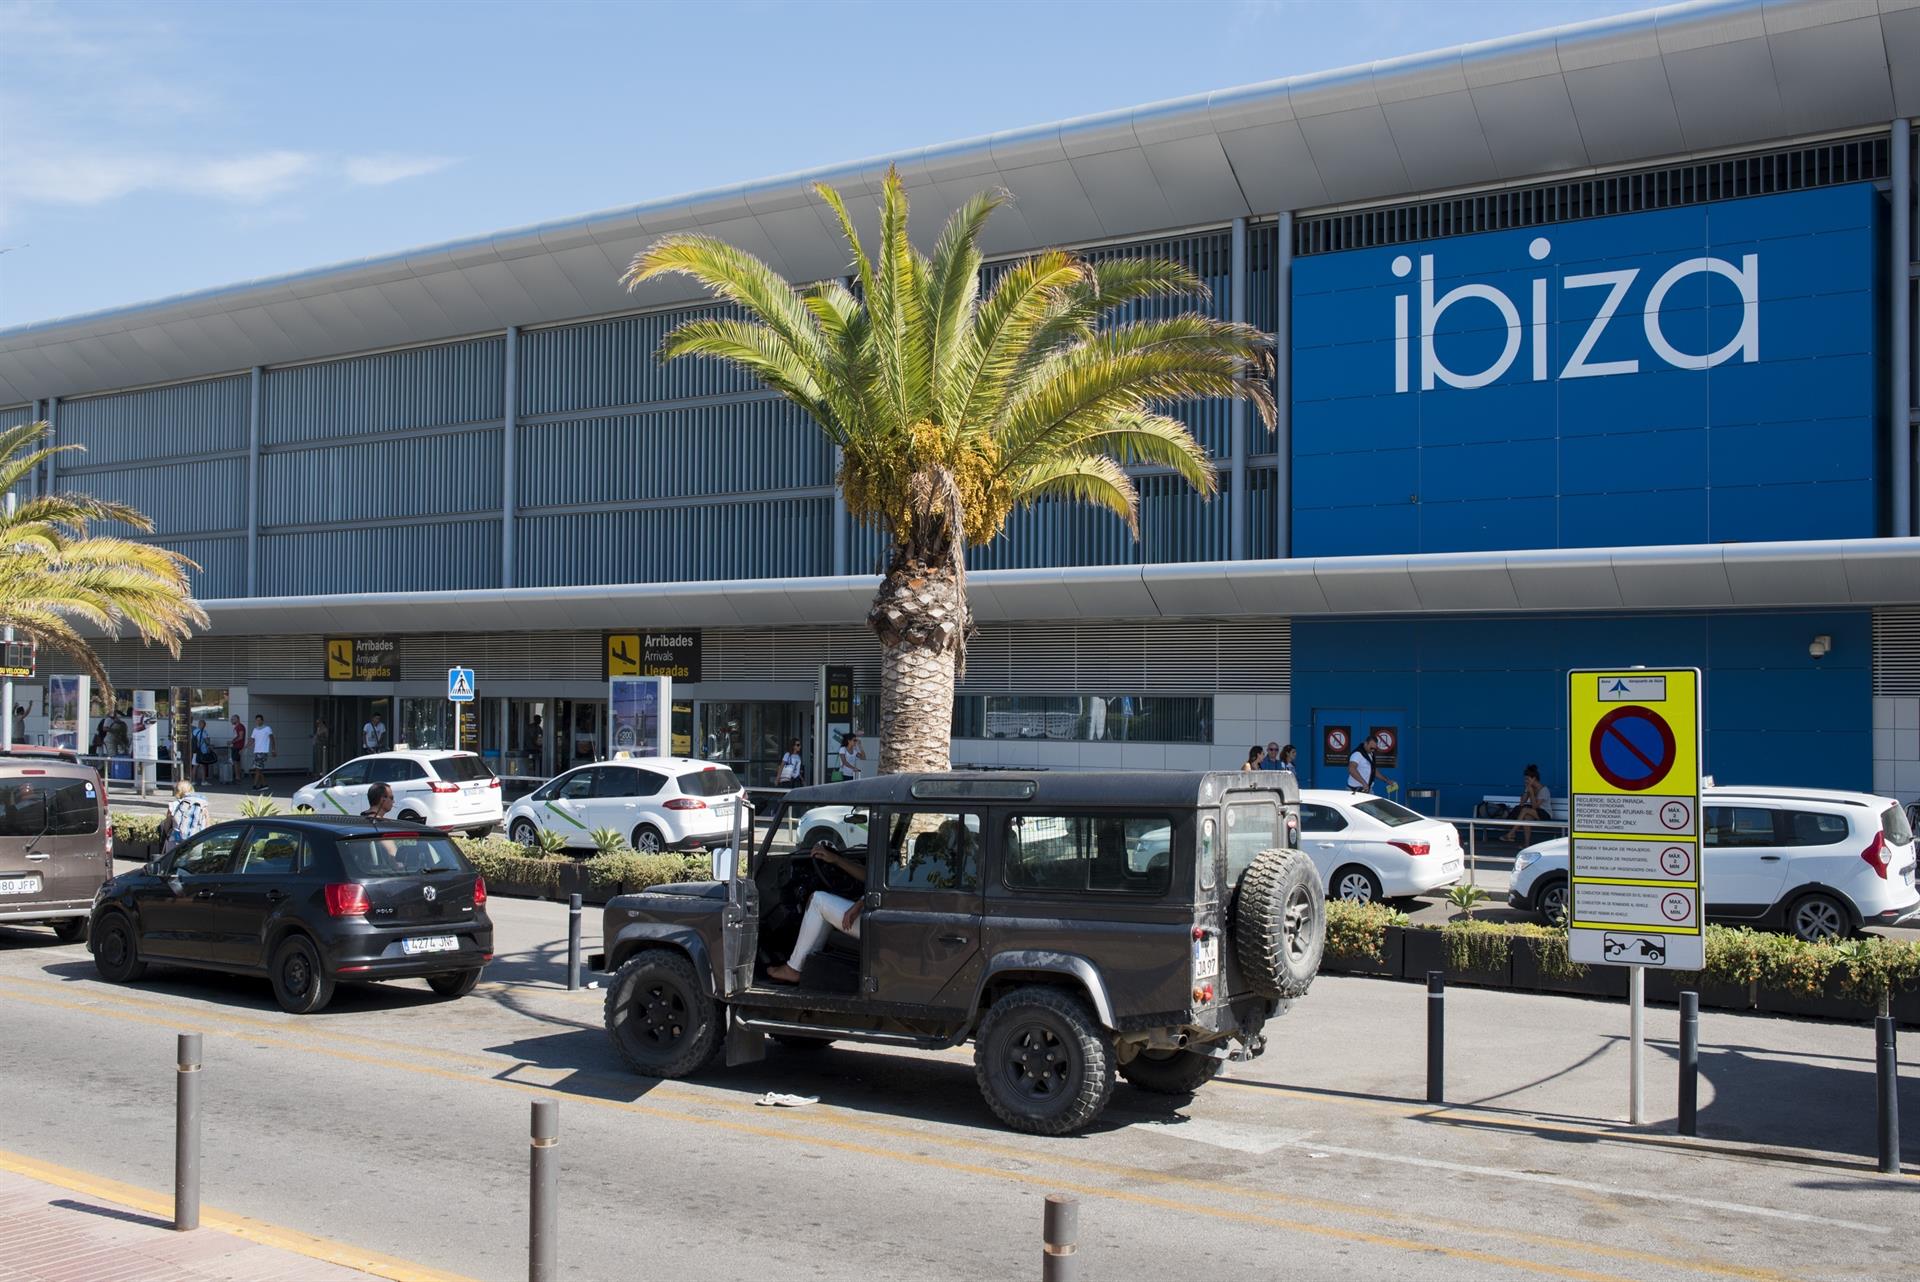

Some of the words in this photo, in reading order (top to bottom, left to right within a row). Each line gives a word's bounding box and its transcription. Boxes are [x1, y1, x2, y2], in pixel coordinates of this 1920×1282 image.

[1391, 237, 1759, 393] ibiza
[356, 639, 394, 651] Arribades
[644, 634, 694, 647] Arribades
[644, 650, 674, 661] Arrivals
[644, 664, 689, 677] Llegadas
[18, 880, 36, 890] JFP
[411, 937, 436, 949] 4274
